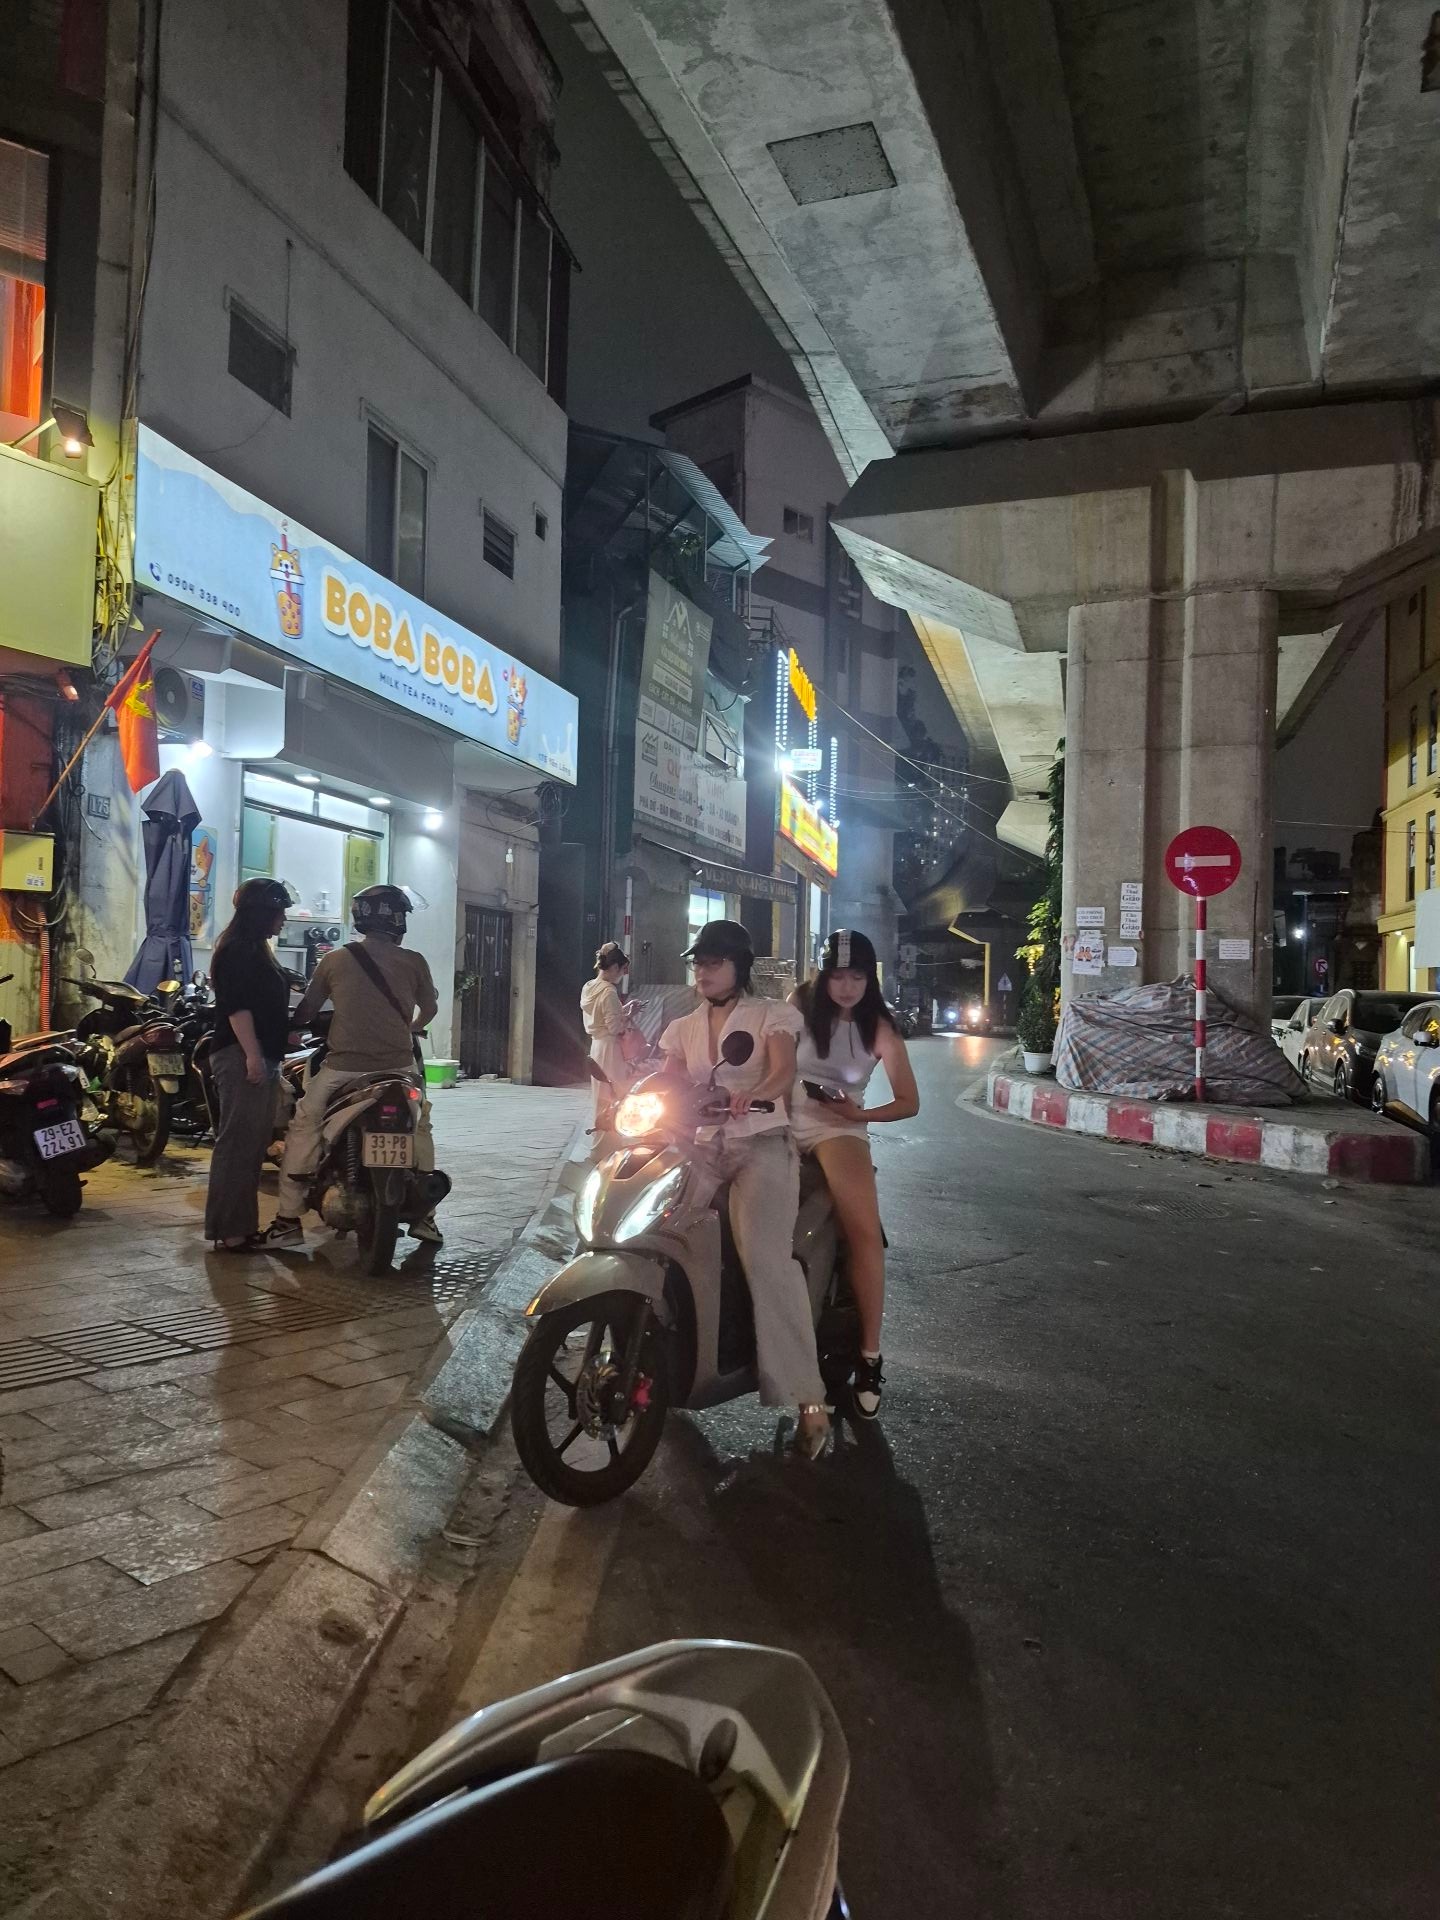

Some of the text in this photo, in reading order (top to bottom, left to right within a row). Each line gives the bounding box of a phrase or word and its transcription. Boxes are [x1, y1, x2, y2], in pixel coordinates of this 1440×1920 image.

[167, 573, 195, 595] 0904
[222, 600, 241, 617] 400
[325, 573, 496, 708] BOBA BOBA
[379, 671, 455, 717] MILK TEA FOR YOU
[91, 797, 110, 815] 175
[42, 1133, 84, 1157] 224.91
[371, 1135, 407, 1150] 33-P8
[371, 1150, 407, 1165] 1179
